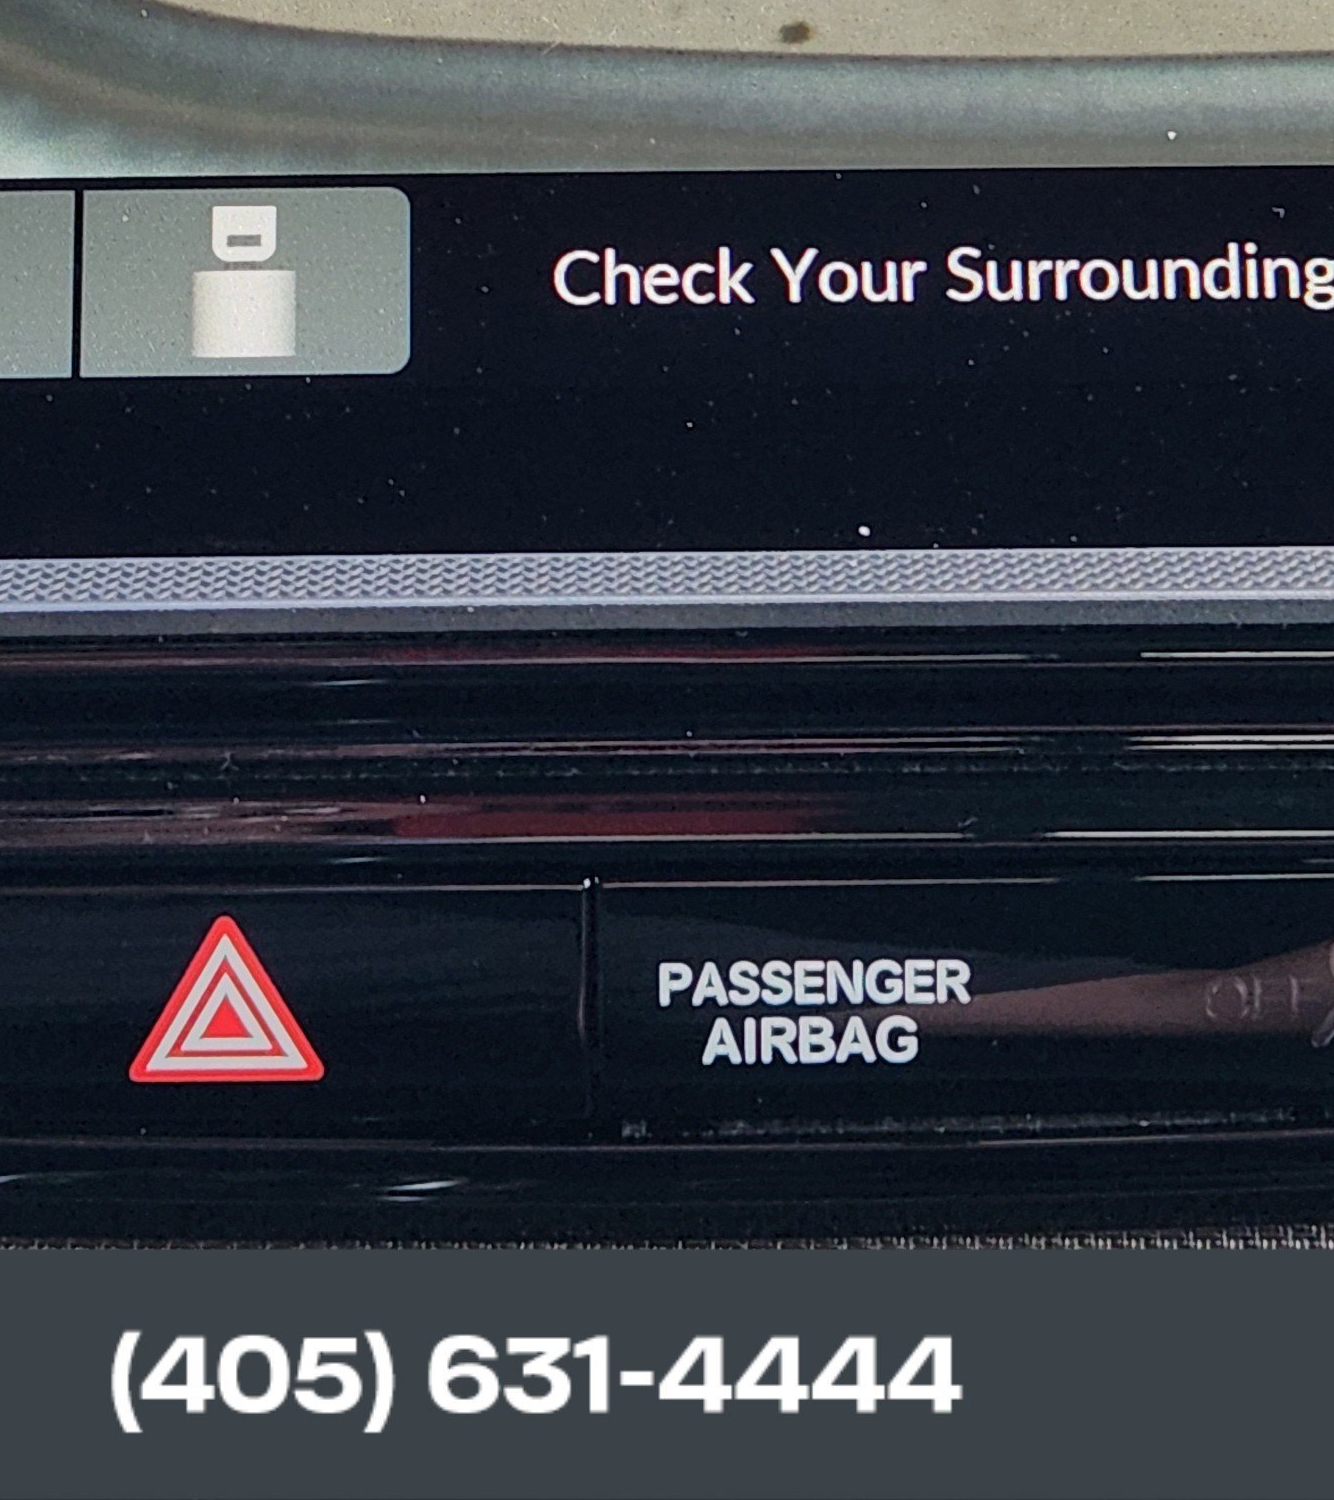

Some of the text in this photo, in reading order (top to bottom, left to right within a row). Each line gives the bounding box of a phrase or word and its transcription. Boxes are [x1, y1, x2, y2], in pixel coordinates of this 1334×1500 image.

[552, 247, 755, 306] Check
[770, 247, 927, 304] Your
[658, 958, 972, 1008] PASSENGER
[701, 1014, 919, 1066] AIRBAG
